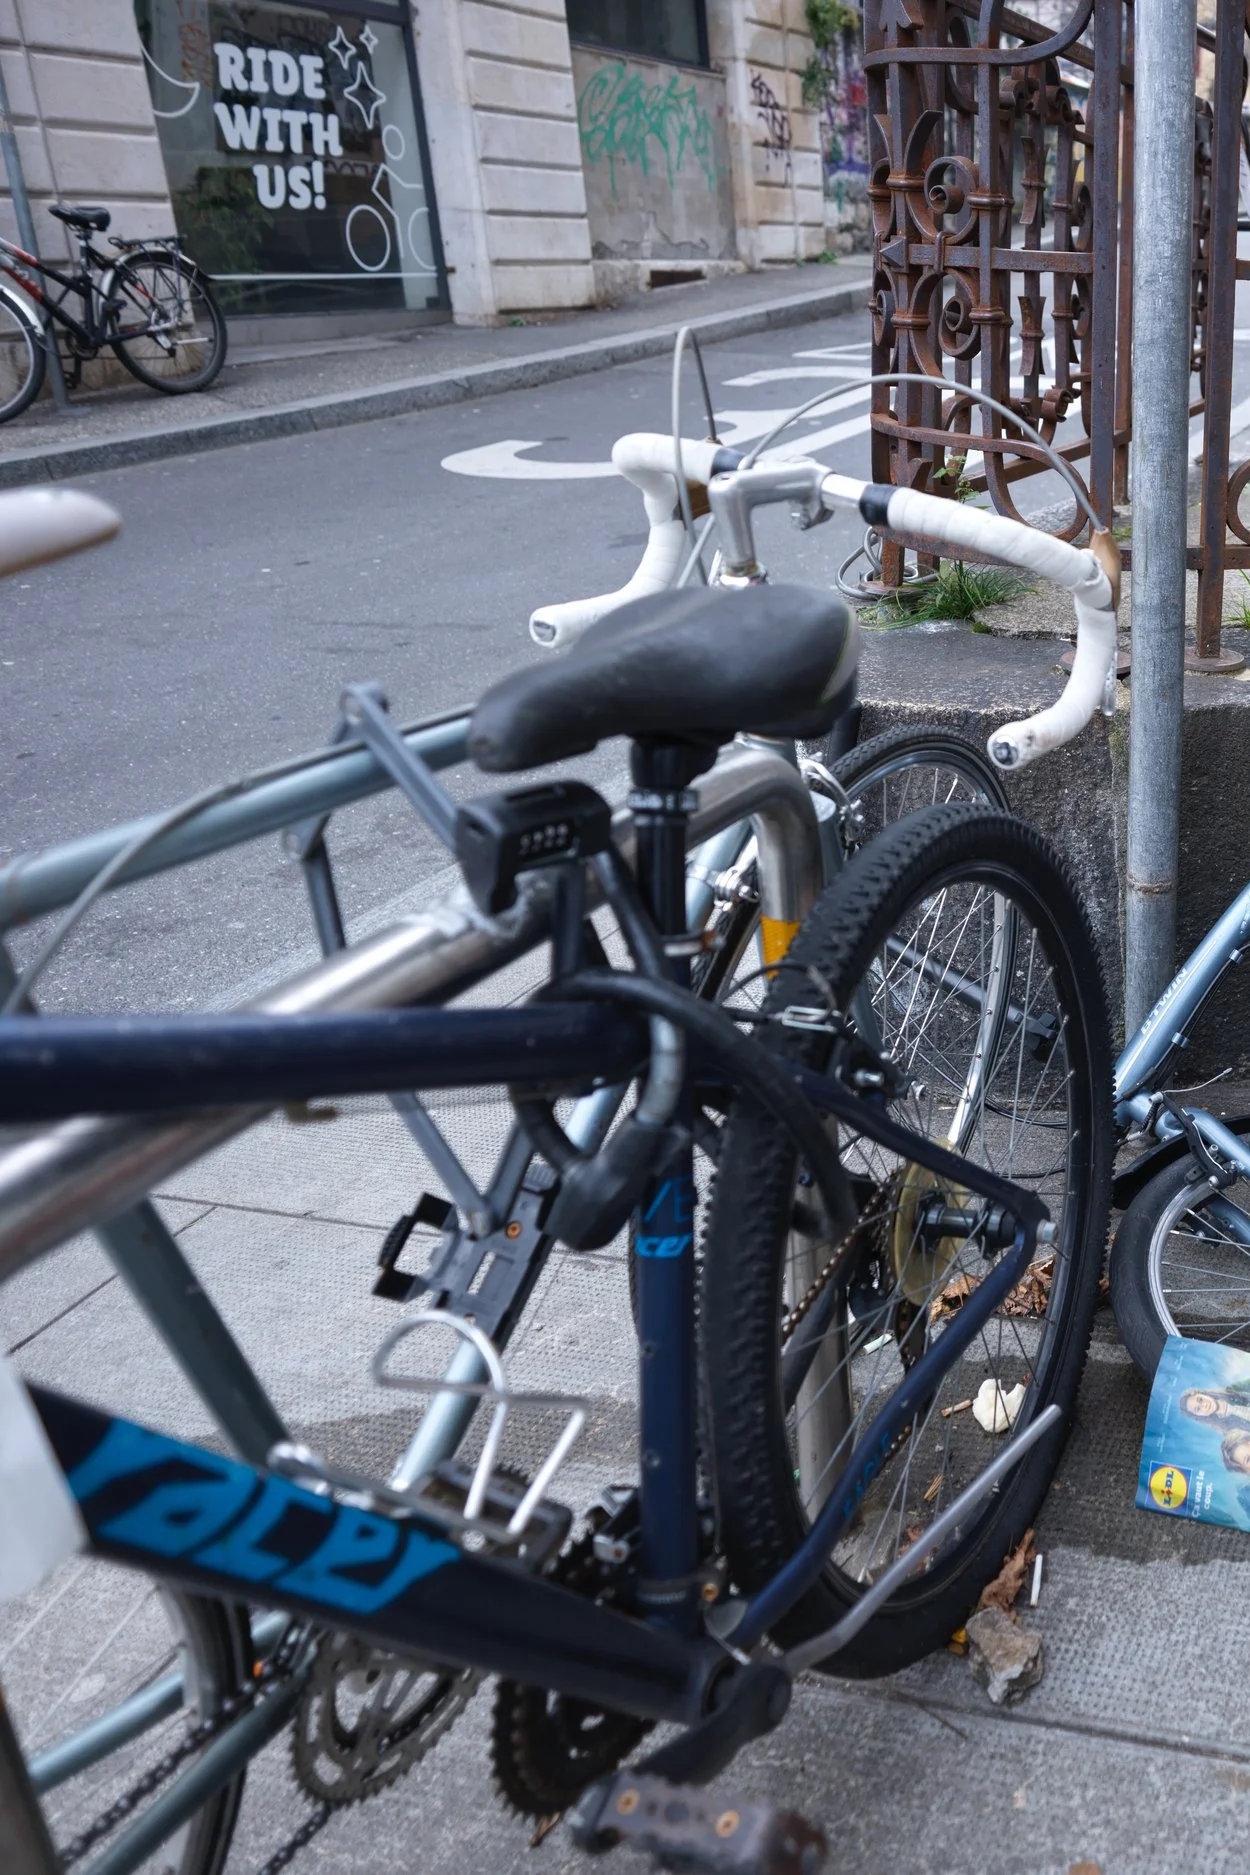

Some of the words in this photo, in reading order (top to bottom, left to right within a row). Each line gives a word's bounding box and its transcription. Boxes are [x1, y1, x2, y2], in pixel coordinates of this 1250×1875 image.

[213, 42, 326, 99] RIDE
[213, 102, 343, 157] WITH
[253, 160, 326, 210] US!
